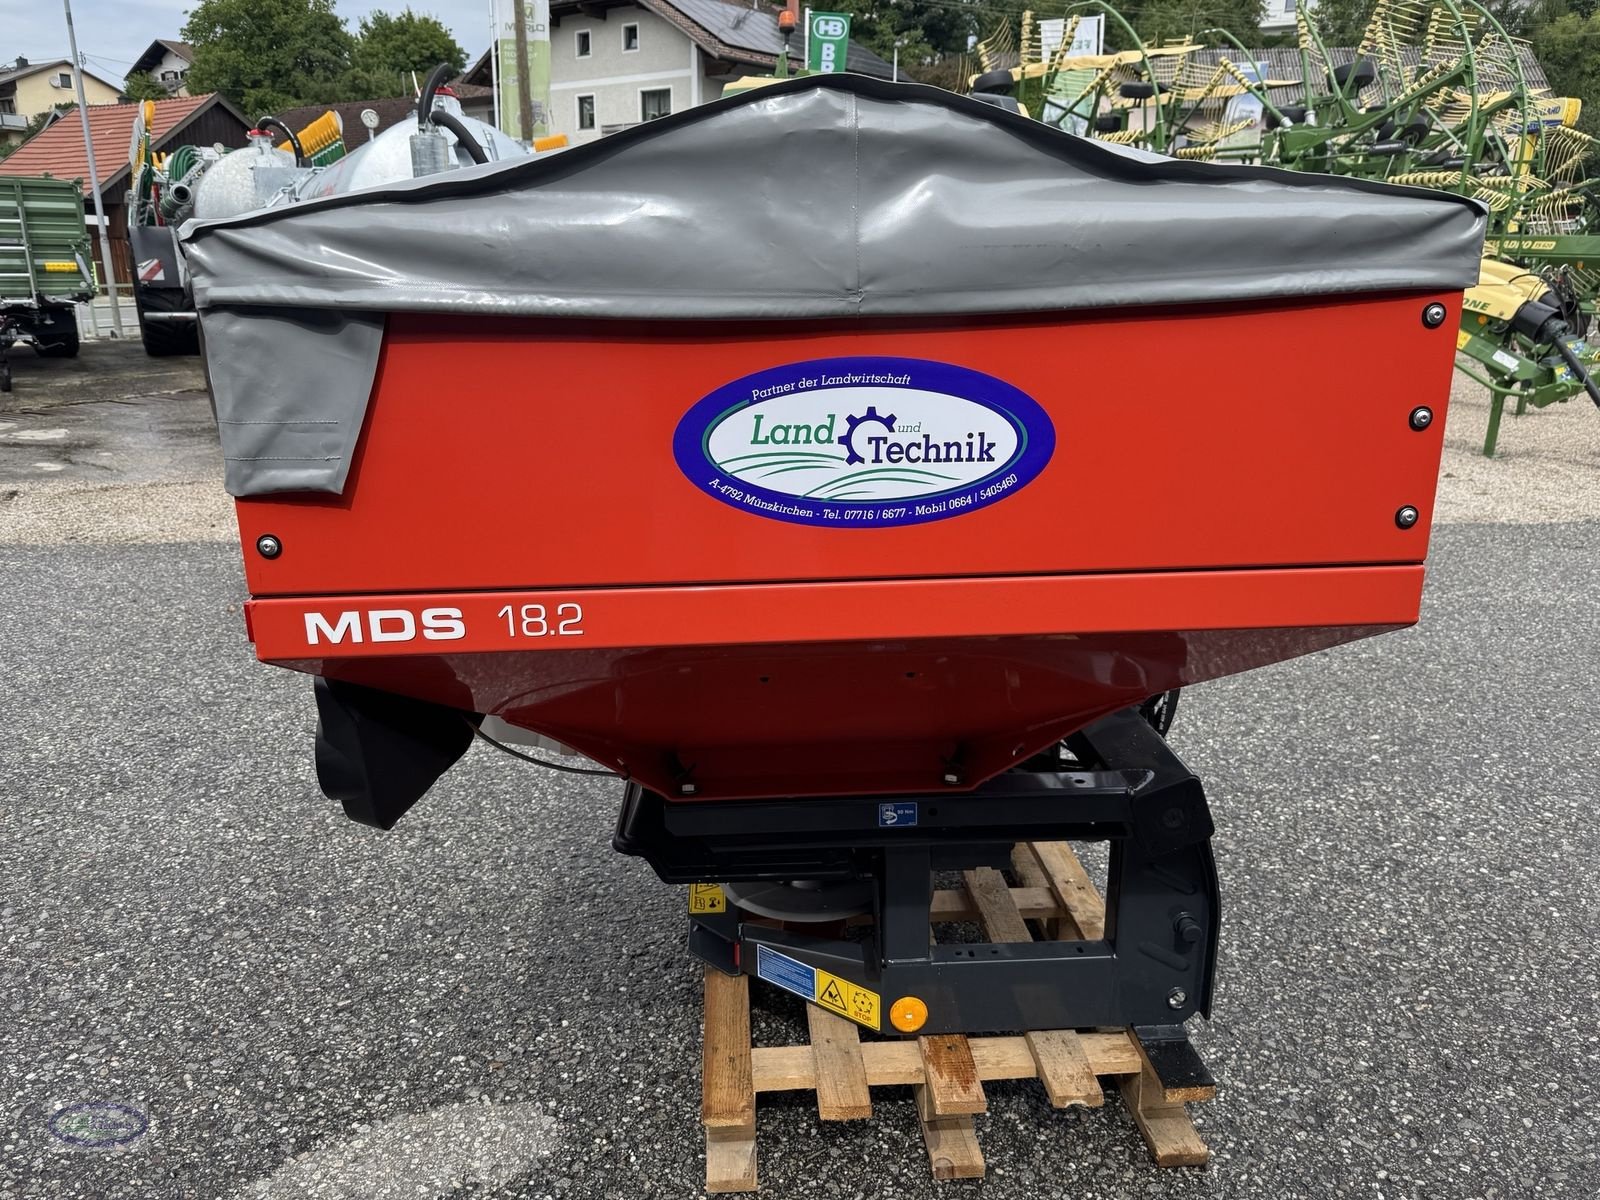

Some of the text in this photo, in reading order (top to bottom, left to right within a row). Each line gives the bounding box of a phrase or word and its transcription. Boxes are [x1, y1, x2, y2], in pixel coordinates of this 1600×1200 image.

[504, 22, 545, 32] MRLO
[818, 20, 843, 35] HB
[752, 373, 911, 400] Partner der Landwirtschaft
[750, 414, 996, 464] Land und Technik
[708, 478, 744, 501] A-4792
[743, 493, 813, 518] Münzkirchen
[823, 508, 842, 520] Tel.
[844, 509, 874, 520] 07716
[882, 507, 907, 519] 6677
[915, 501, 947, 516] Mobil
[948, 494, 973, 509] 0664
[979, 473, 1018, 500] 5405460
[303, 603, 584, 645] MDS 18.2
[854, 1010, 872, 1022] STOP
